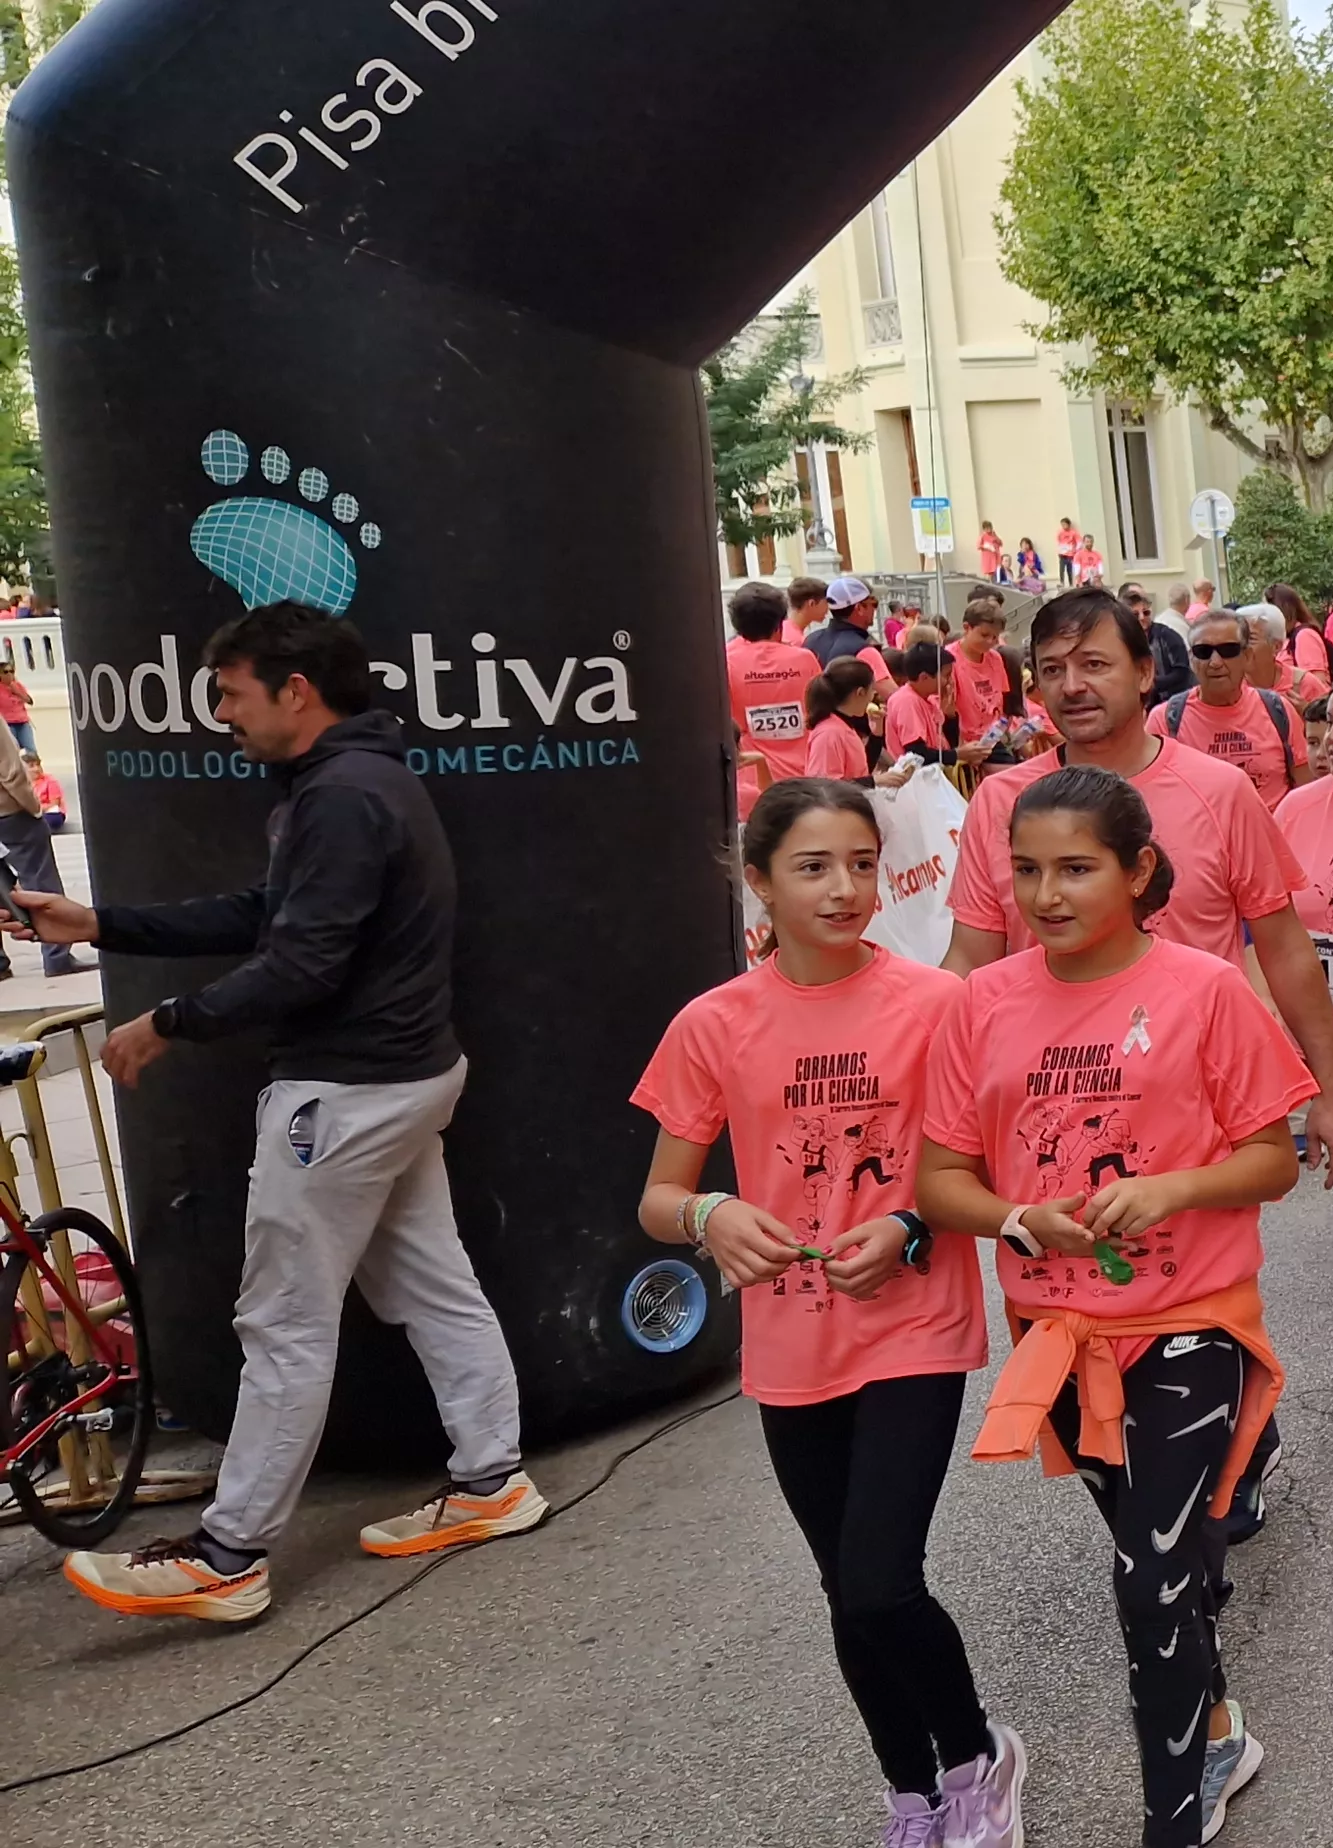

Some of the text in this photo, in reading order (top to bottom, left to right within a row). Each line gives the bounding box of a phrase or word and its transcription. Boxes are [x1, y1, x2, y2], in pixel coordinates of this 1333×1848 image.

[233, 58, 423, 213] Pisa
[754, 714, 799, 732] 2520
[795, 1051, 867, 1083] CORRAMOS
[1041, 1043, 1114, 1071] CORRAMOS
[783, 1075, 879, 1110] POR LA CIENCIA
[1026, 1066, 1121, 1097] POR LA CIENCIA
[1170, 1335, 1200, 1349] NIKE
[194, 1568, 262, 1593] SCARPA
